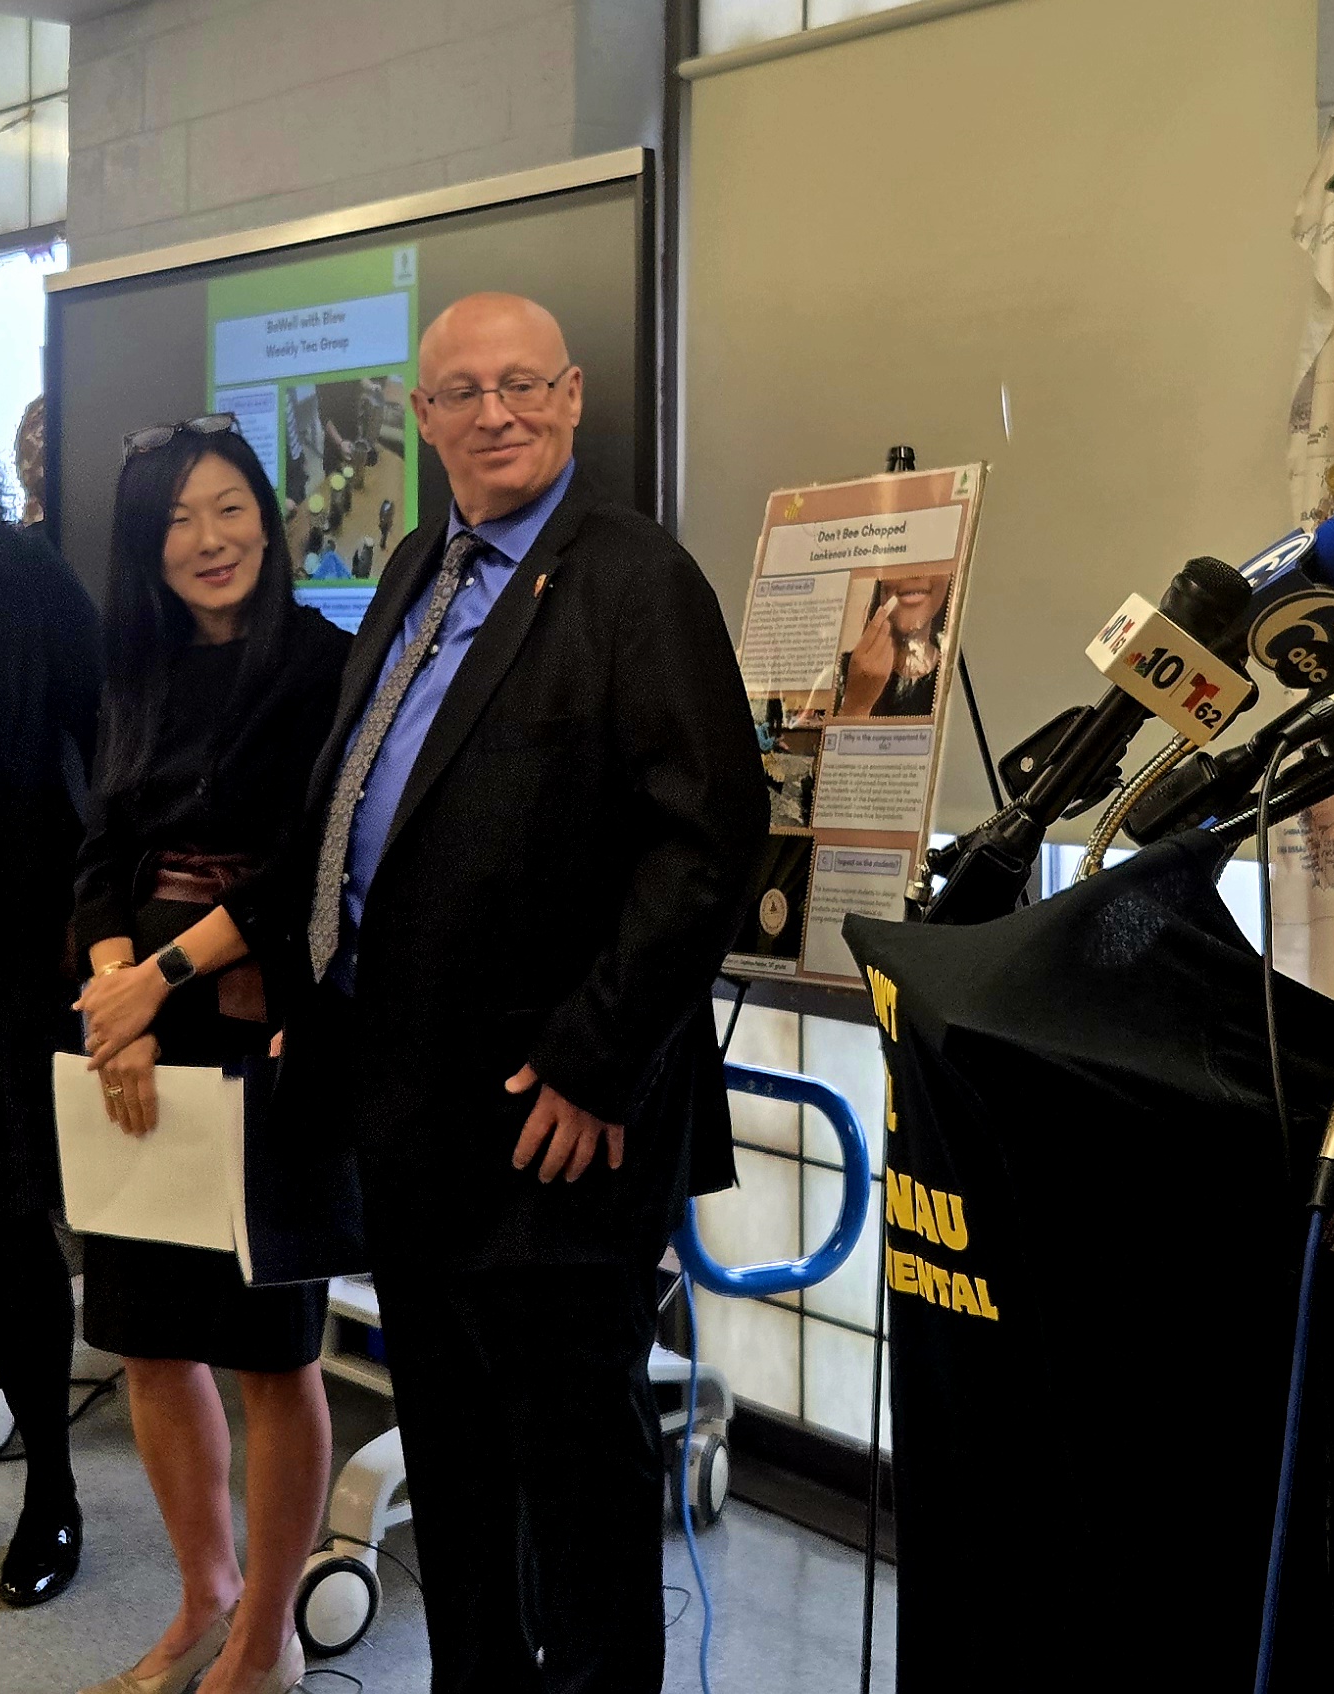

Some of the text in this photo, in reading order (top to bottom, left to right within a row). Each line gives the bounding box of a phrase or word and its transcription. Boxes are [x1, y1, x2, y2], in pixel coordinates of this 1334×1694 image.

[842, 527, 859, 539] Bee
[861, 521, 907, 539] Chapped
[1142, 647, 1185, 690] 10
[1287, 647, 1329, 683] abc
[1194, 702, 1223, 730] 62
